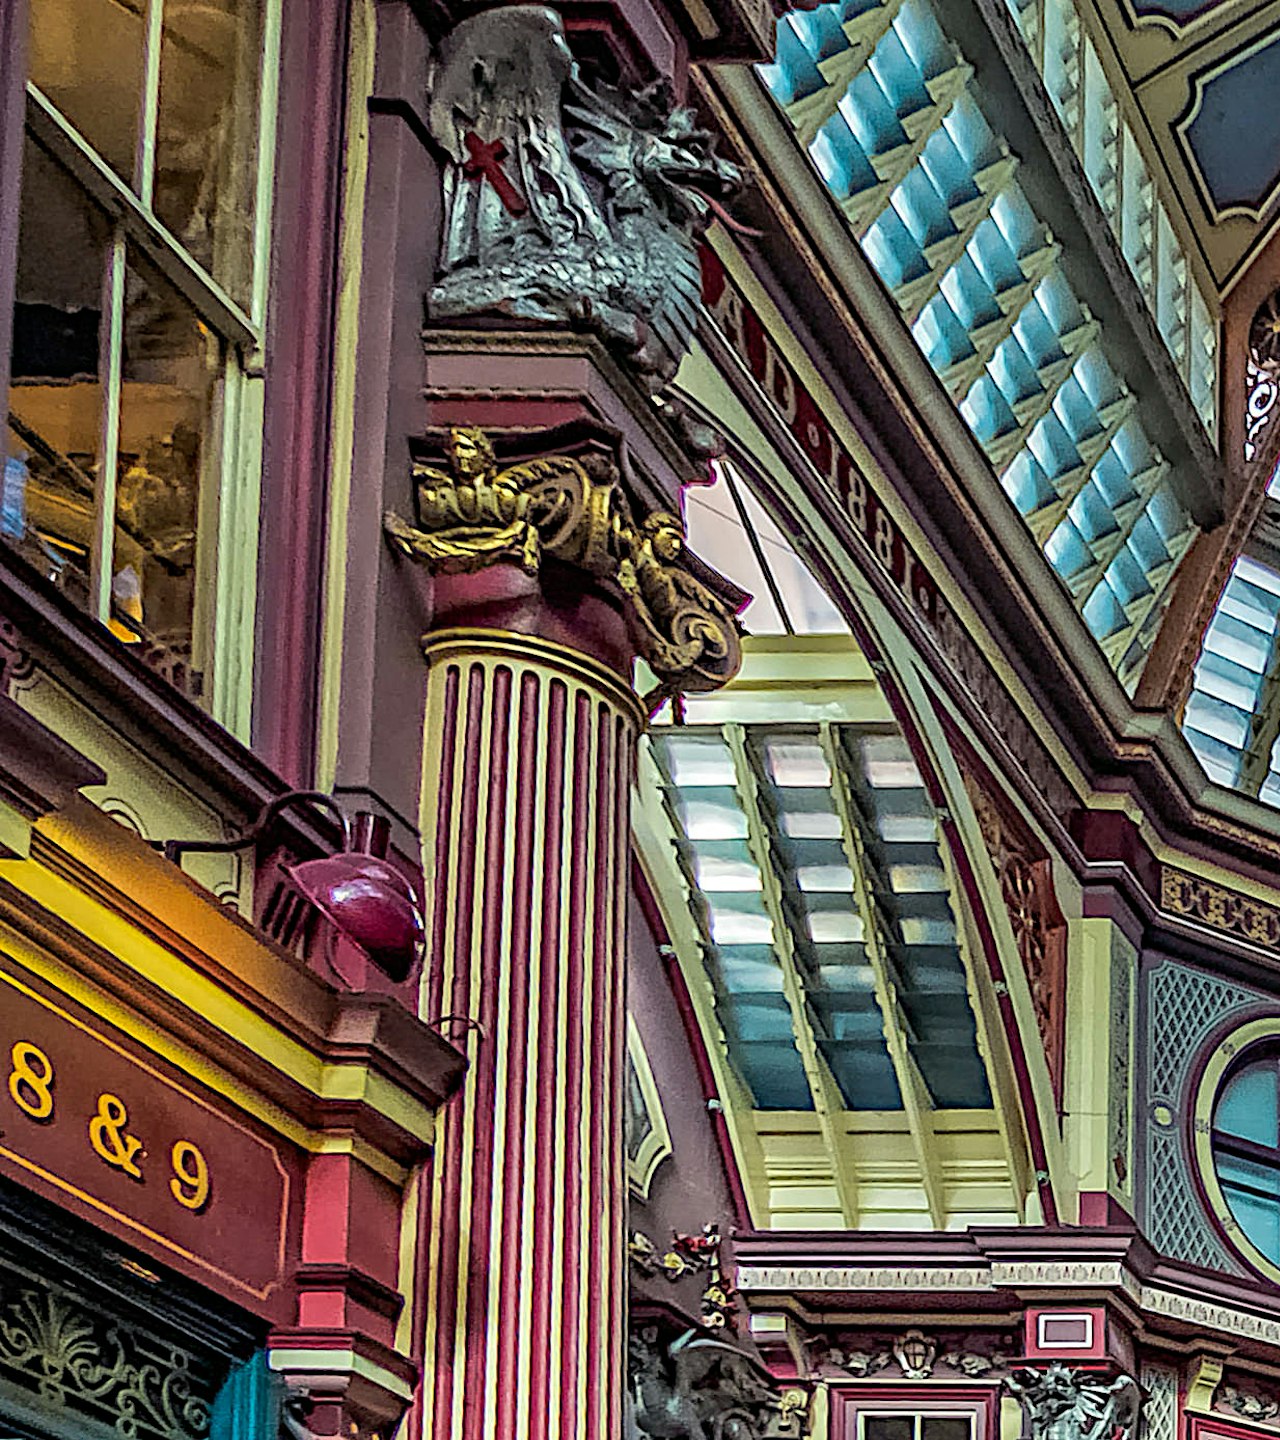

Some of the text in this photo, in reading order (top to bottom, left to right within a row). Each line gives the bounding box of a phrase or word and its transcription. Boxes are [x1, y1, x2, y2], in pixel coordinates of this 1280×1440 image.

[9, 1041, 209, 1210] 8 & 9
